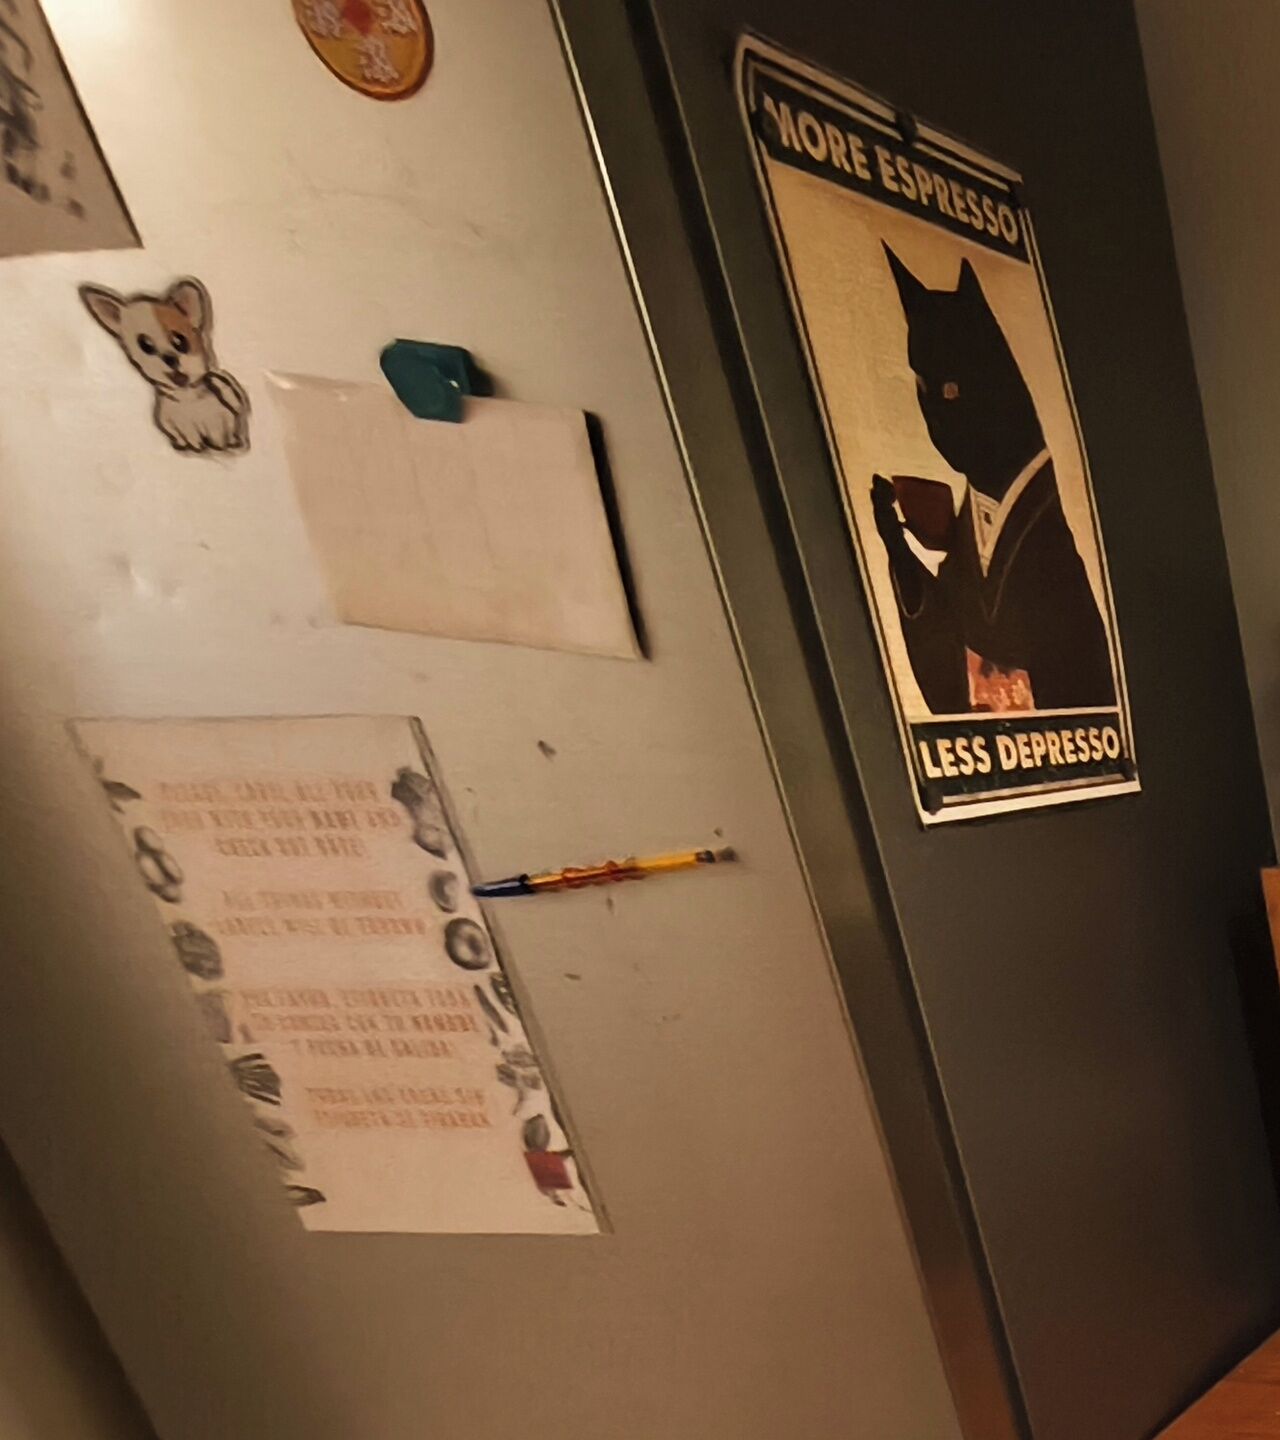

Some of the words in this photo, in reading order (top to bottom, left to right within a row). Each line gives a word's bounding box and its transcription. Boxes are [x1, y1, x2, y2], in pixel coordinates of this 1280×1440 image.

[763, 92, 871, 181] MORE
[875, 145, 1019, 245] ESPRESSO
[919, 736, 992, 779] LESS
[996, 726, 1120, 771] DEPRESSO
